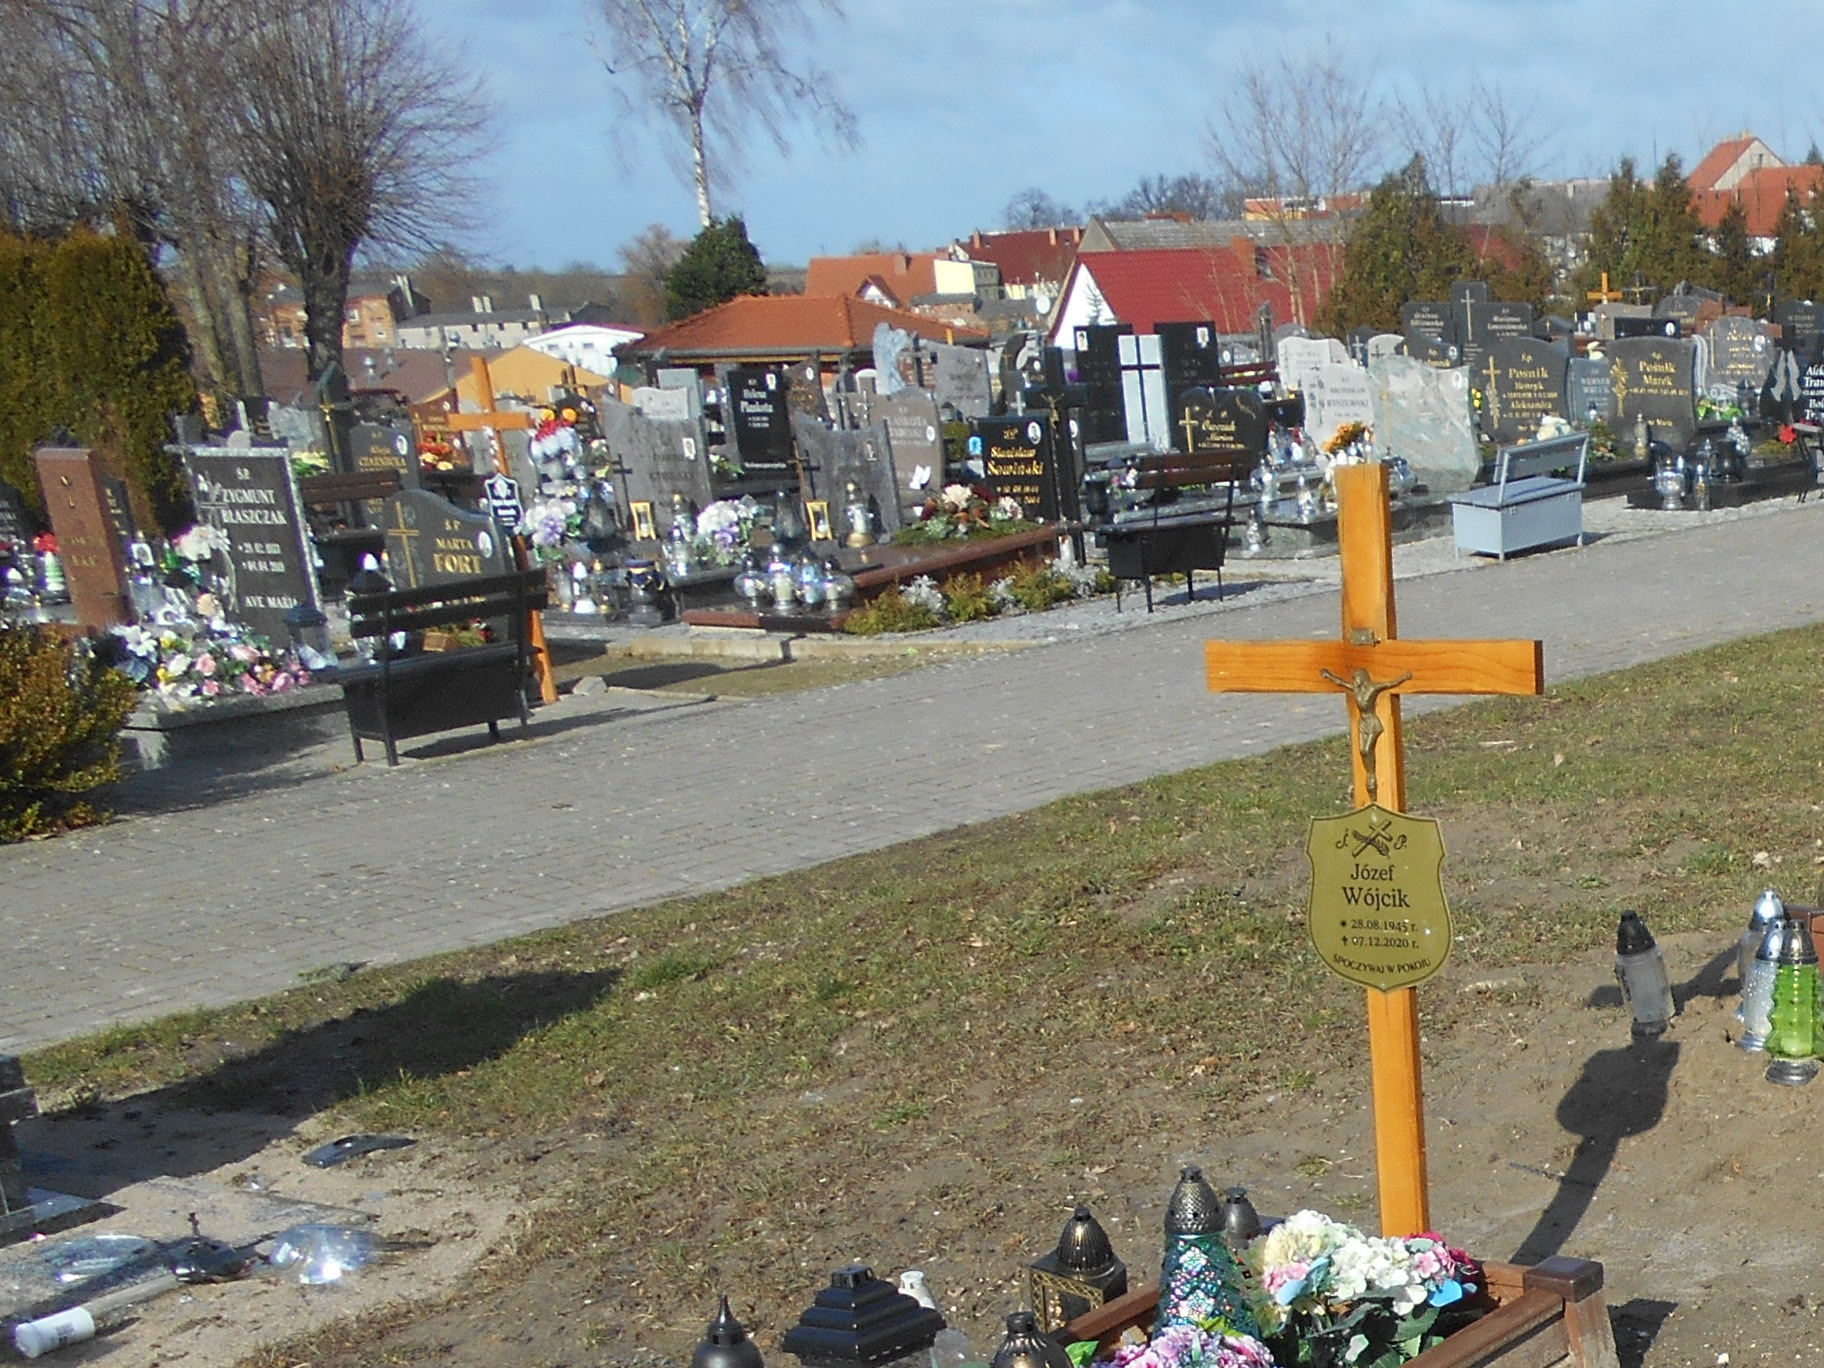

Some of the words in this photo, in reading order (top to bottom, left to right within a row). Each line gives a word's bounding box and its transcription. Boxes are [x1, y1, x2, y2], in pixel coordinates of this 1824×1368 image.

[222, 488, 276, 504] ZYGMUNT
[433, 553, 482, 574] FORT
[1350, 862, 1396, 882] Józef
[1341, 885, 1410, 912] Wójcik
[1351, 919, 1409, 933] 28.08.1945
[1351, 936, 1409, 949] 07.12.2020
[1333, 953, 1385, 974] SPOCZYWAJ
[1397, 957, 1431, 974] POKOJU
